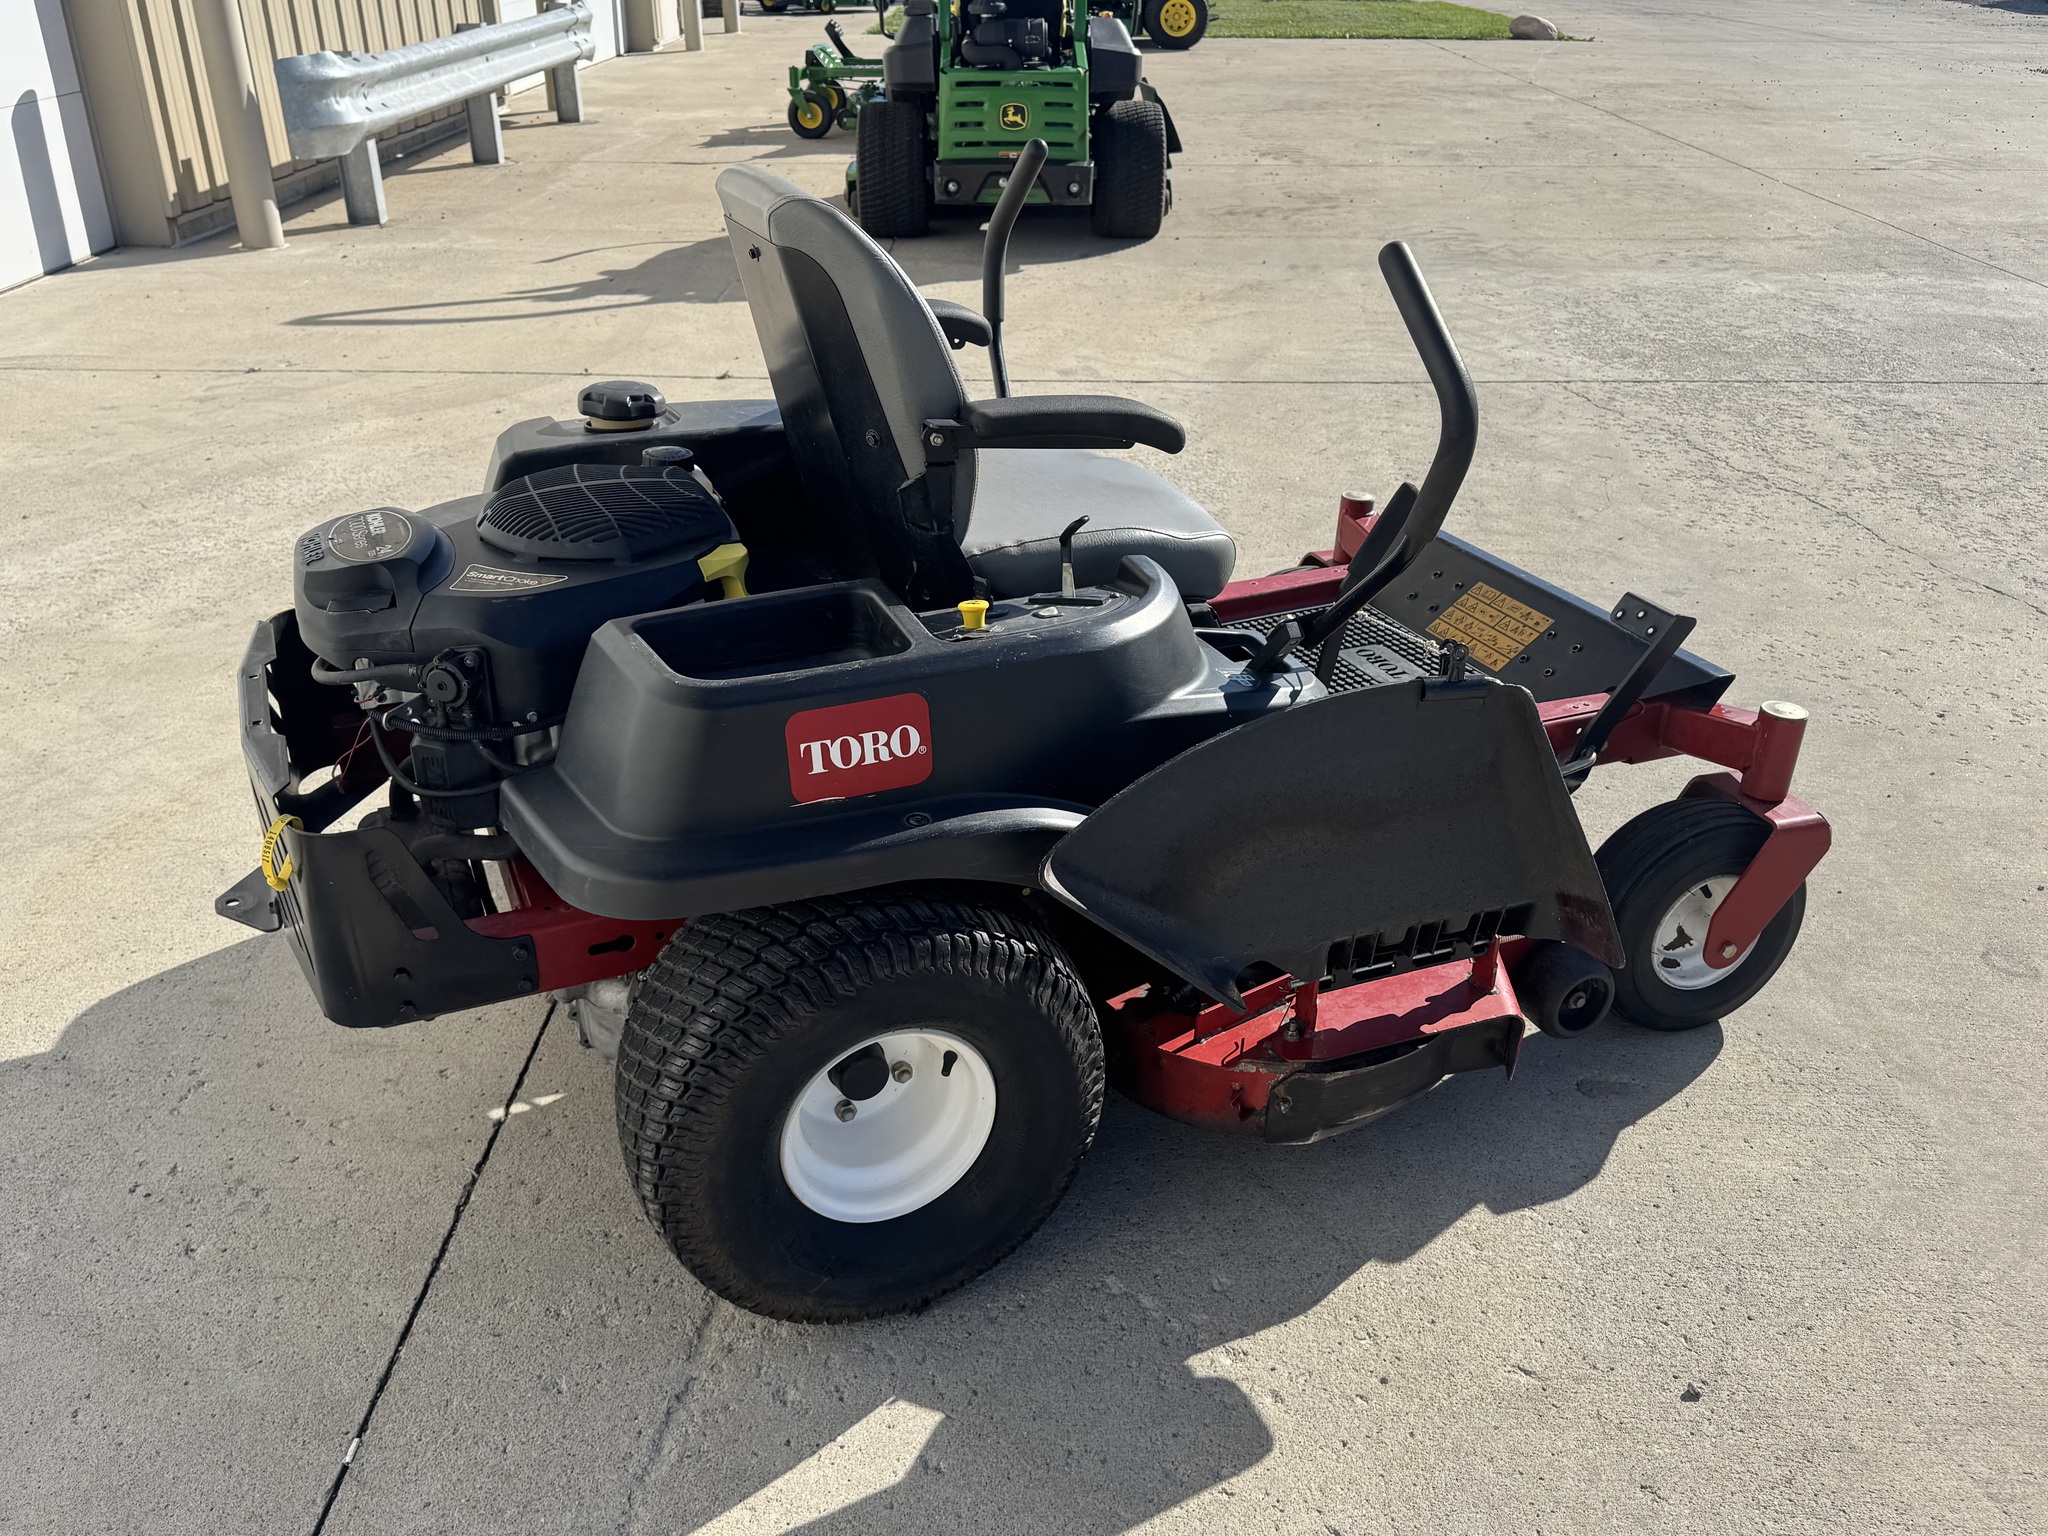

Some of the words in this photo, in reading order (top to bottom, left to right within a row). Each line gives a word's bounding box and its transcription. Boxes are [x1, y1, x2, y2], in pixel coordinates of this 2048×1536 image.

[366, 512, 387, 537] KOHLER
[466, 571, 538, 586] SmartChoke
[1356, 649, 1408, 679] TORO
